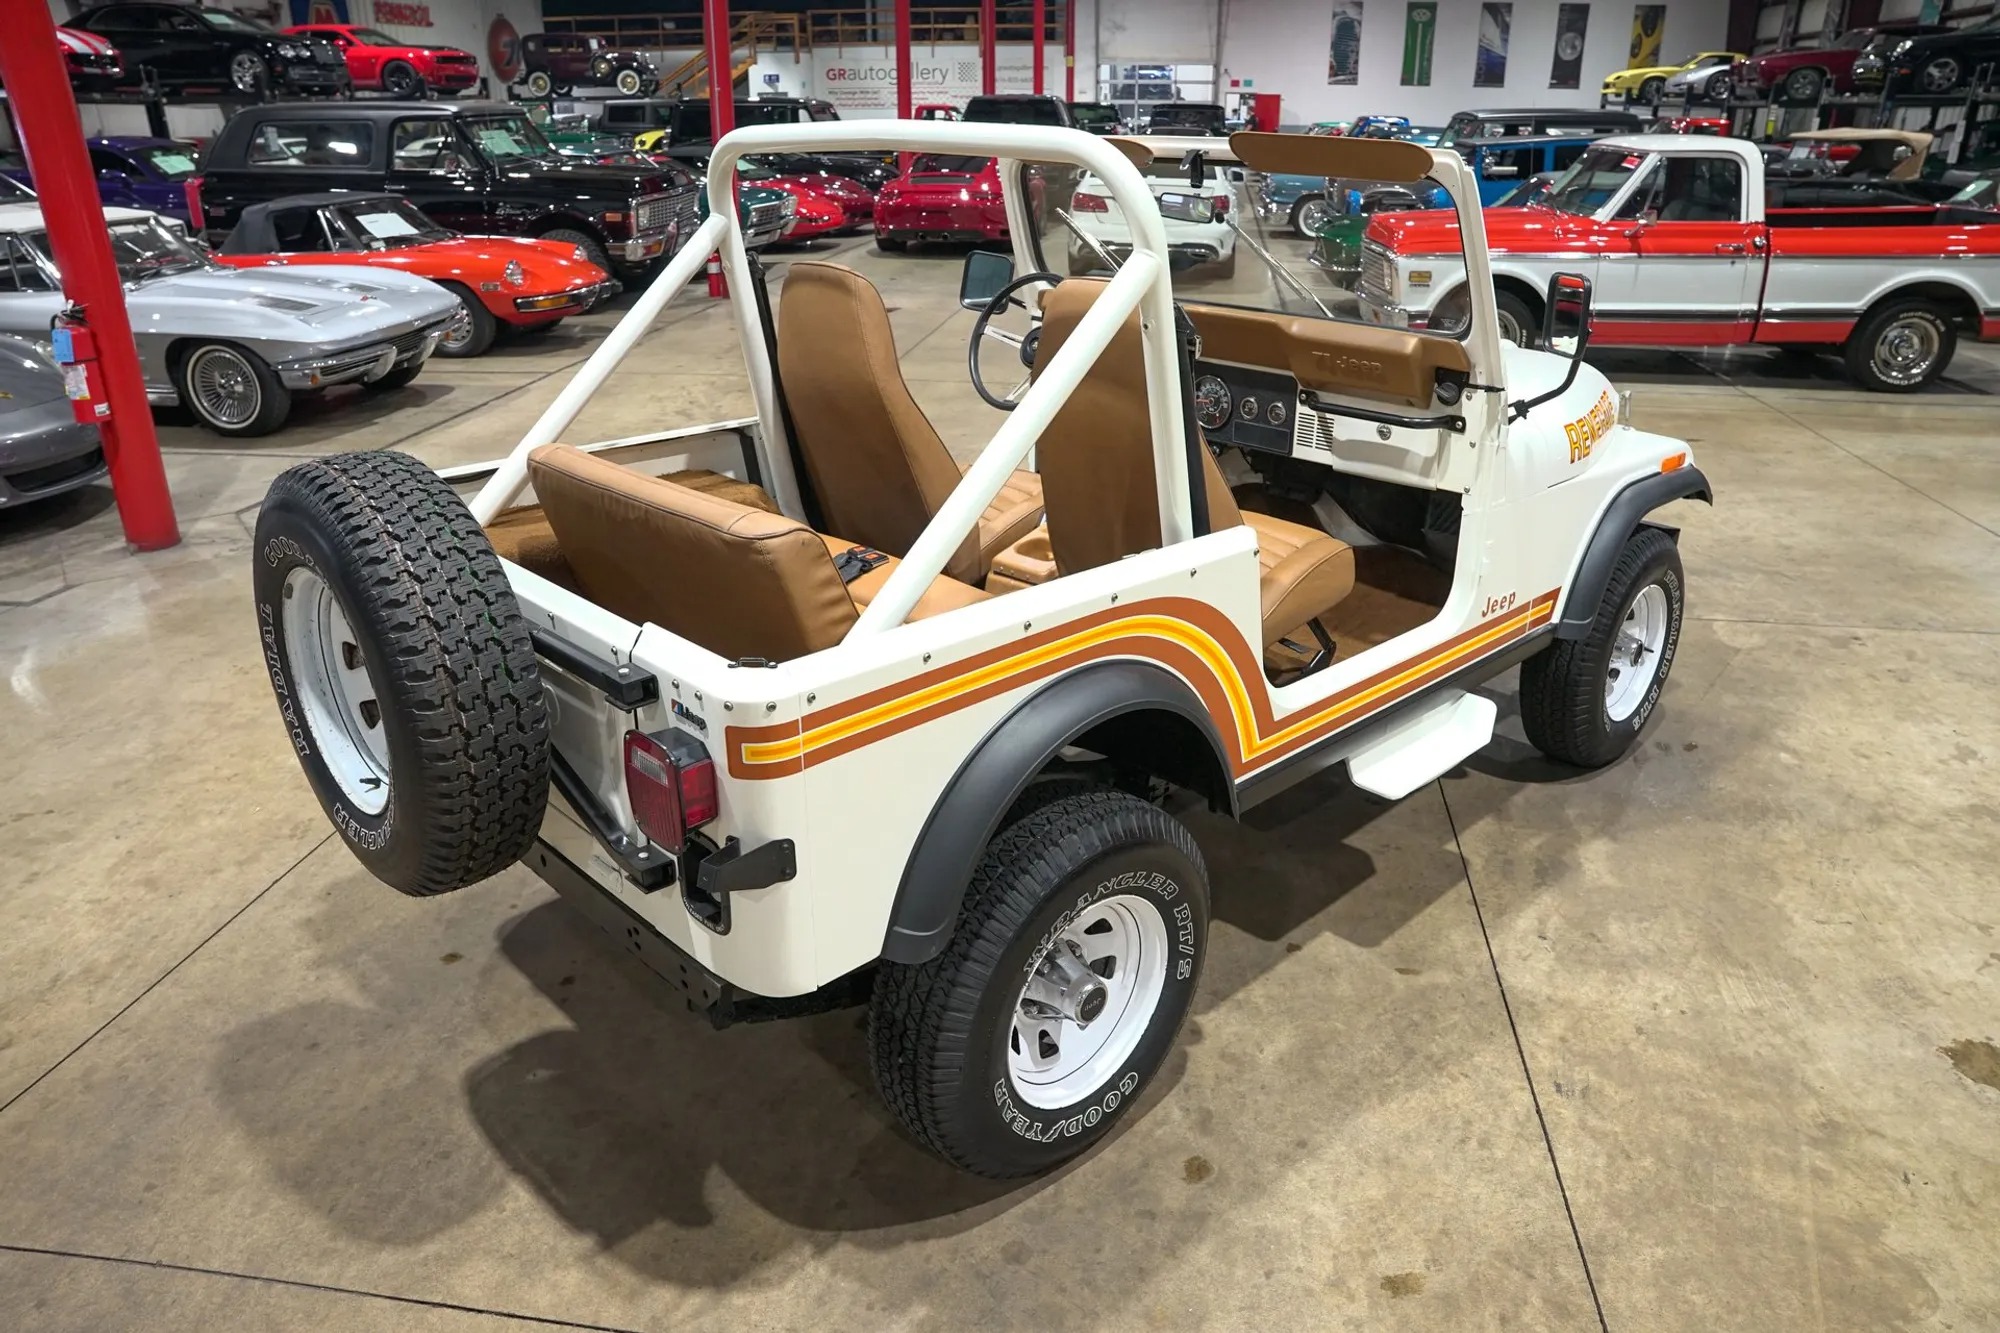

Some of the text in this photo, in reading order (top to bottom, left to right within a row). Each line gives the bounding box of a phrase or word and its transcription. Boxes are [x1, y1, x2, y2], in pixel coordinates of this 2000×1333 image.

[826, 62, 949, 86] GRautogllery
[1481, 590, 1516, 618] Jeep
[260, 603, 309, 757] RADIAL
[1173, 903, 1195, 981] RT/S
